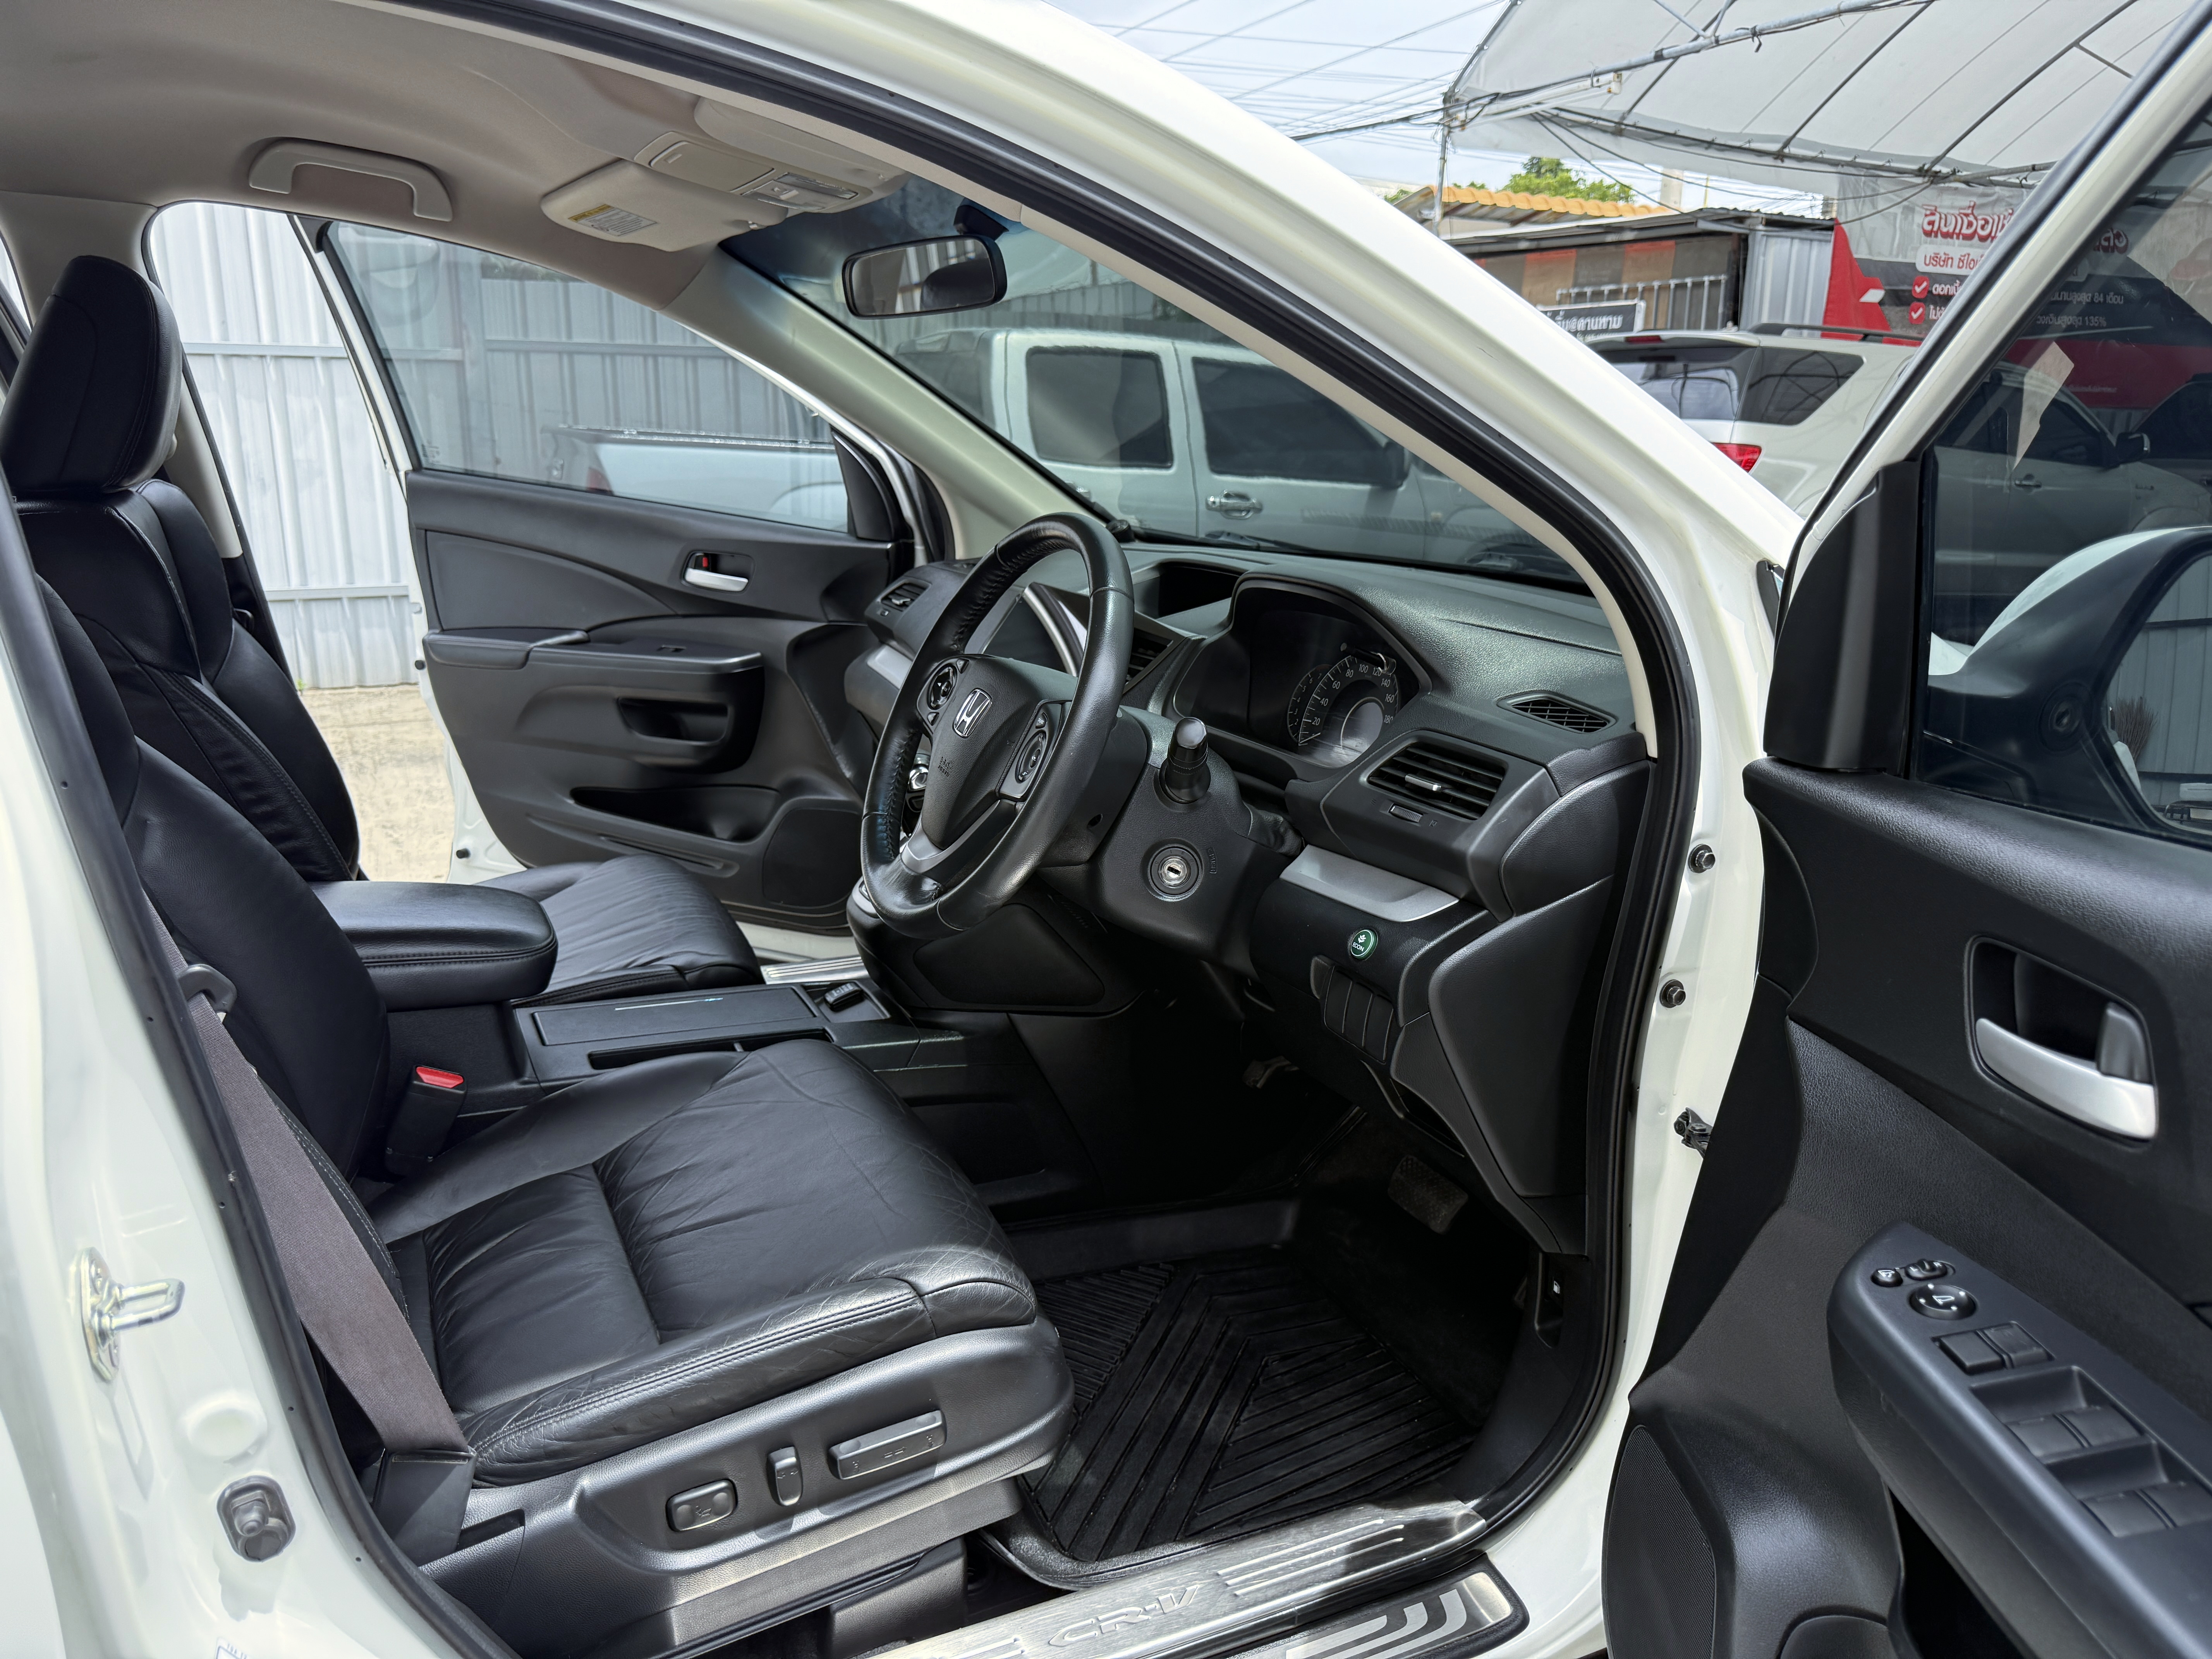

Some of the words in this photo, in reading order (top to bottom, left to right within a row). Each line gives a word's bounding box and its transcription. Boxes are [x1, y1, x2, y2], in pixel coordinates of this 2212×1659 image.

[1923, 252, 1953, 268] บริษัท
[2094, 292, 2103, 304] 84
[1358, 664, 1369, 673] 100
[1372, 667, 1382, 677] 120
[1345, 669, 1353, 678] 80
[1332, 681, 1340, 689] 60
[1381, 678, 1390, 687] 140
[1320, 698, 1328, 706] 40
[1385, 694, 1394, 703] 160
[1312, 717, 1320, 726] 20
[1352, 942, 1364, 952] ECON
[1048, 1584, 1200, 1647] CR-V
